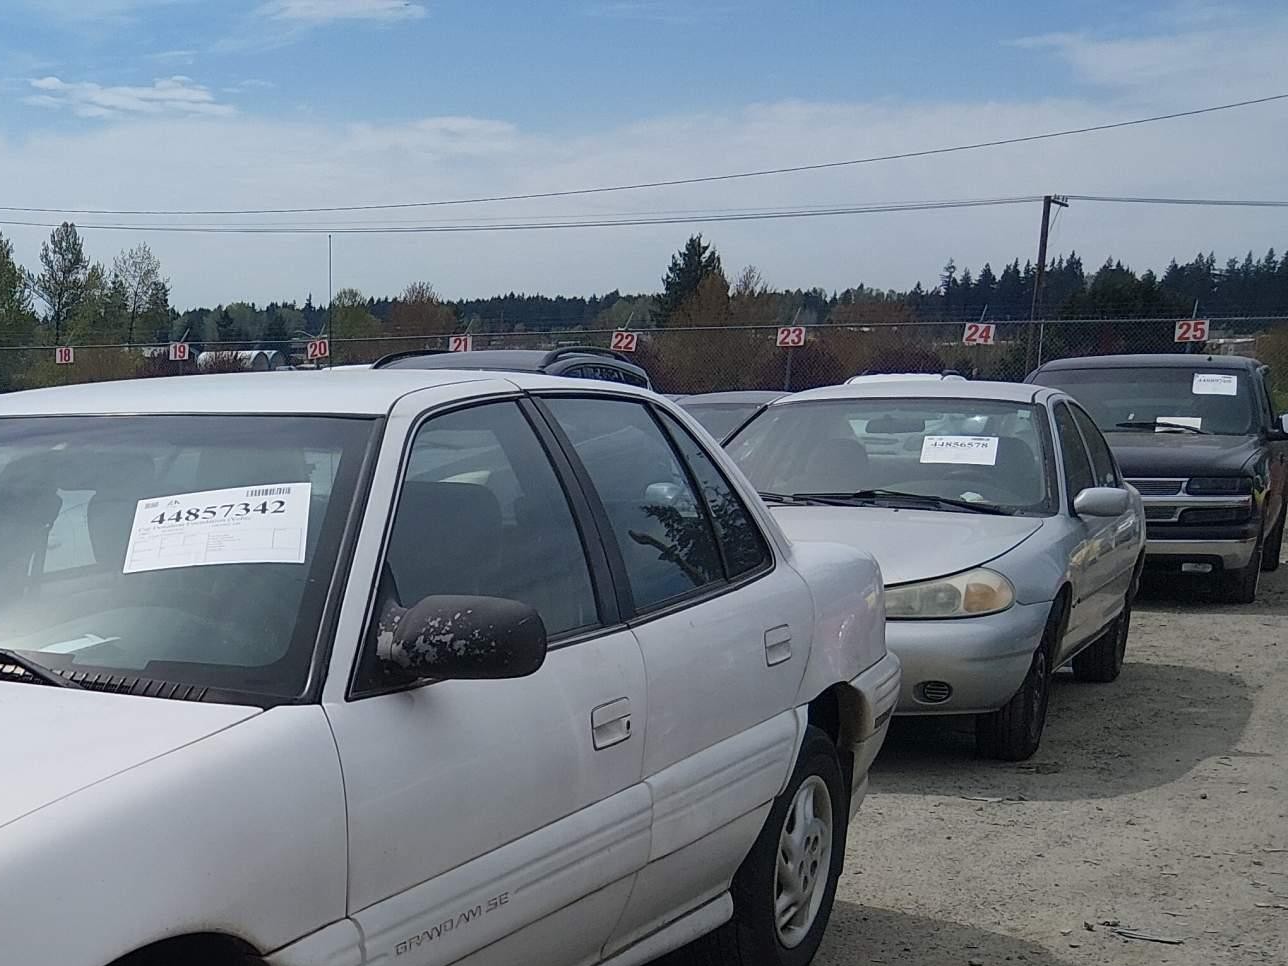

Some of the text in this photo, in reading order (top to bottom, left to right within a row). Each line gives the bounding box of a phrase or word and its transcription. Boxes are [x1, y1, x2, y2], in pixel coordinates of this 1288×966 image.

[779, 328, 802, 345] 23
[965, 324, 991, 343] 24
[1177, 321, 1205, 340] 25
[310, 341, 327, 357] 20
[454, 338, 468, 352] 21
[613, 333, 634, 350] 22
[59, 349, 71, 362] 18
[174, 344, 186, 359] 19
[930, 441, 989, 449] 44856578
[150, 499, 286, 525] 44857342
[394, 891, 510, 956] GRAND AM SE
